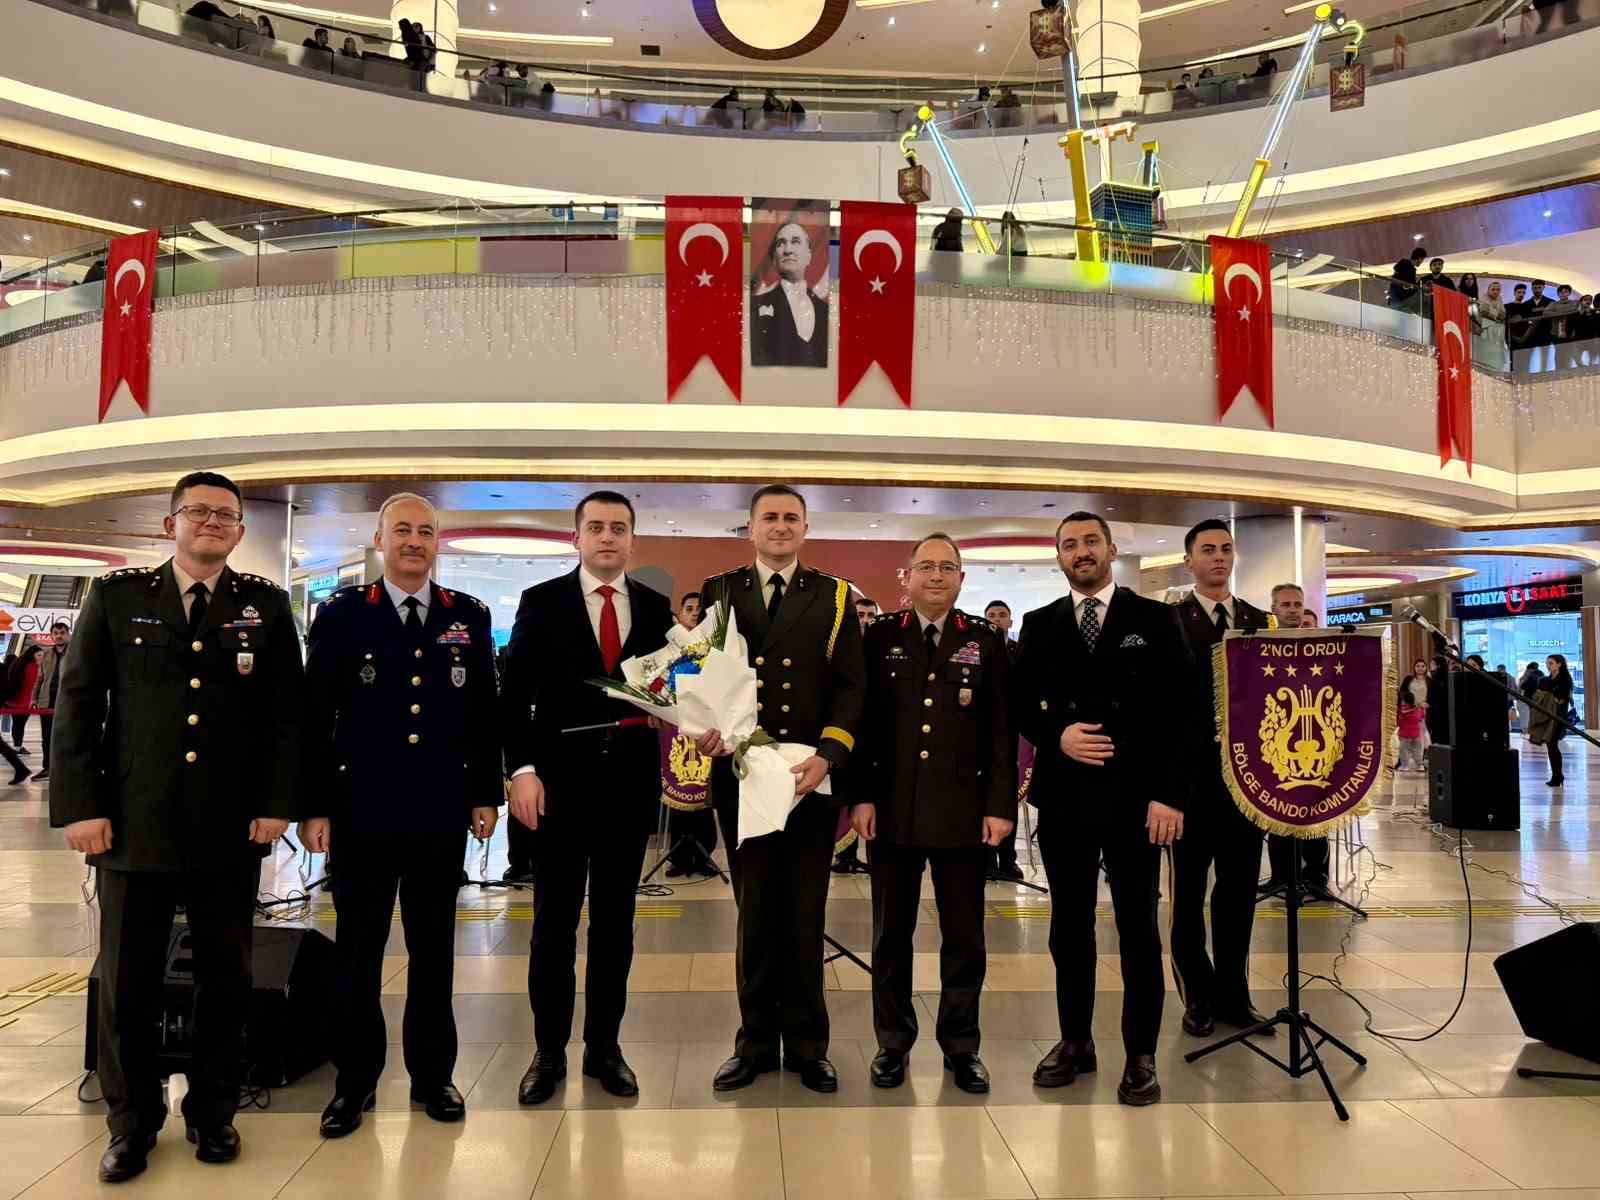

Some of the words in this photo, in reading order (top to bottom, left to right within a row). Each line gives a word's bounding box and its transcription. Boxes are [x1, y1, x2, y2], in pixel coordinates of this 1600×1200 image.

[1327, 612, 1365, 625] KARACA
[1303, 642, 1346, 657] ORDU
[1232, 742, 1261, 794] BÖLGE
[1258, 789, 1309, 818] BANDO
[1310, 740, 1374, 816] KOMUTANLIĞI
